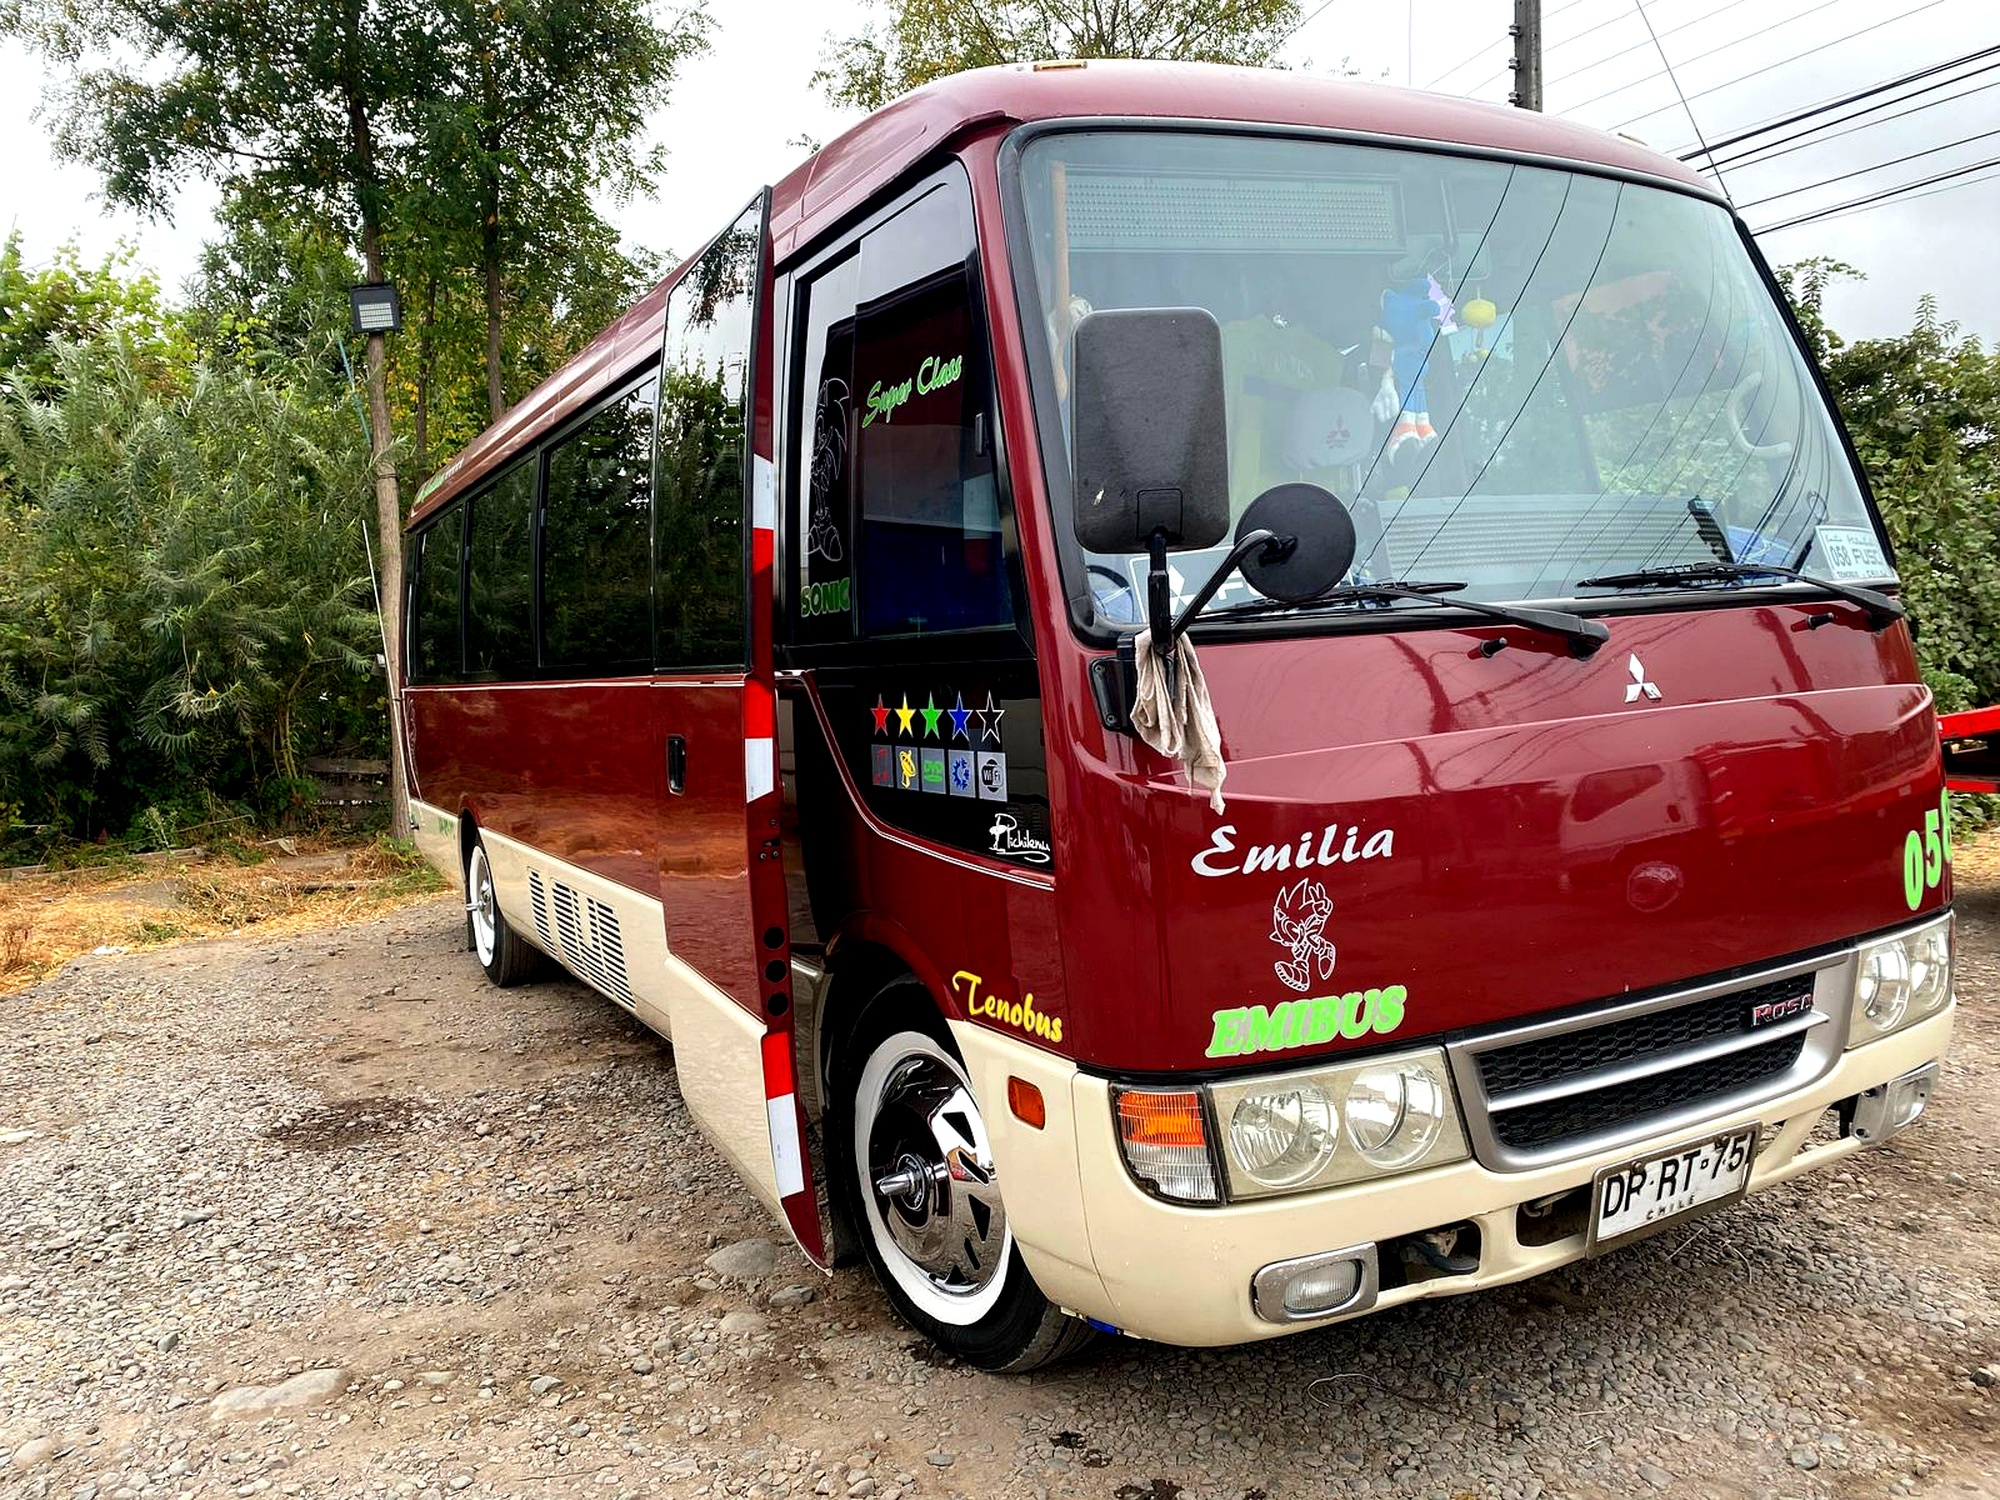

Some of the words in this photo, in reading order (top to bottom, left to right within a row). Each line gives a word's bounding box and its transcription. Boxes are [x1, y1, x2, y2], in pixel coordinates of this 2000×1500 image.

[861, 381, 911, 428] Super
[917, 355, 963, 395] Class
[801, 577, 850, 618] SONIC
[1191, 824, 1395, 876] Emilia
[952, 970, 1063, 1042] Tenobus
[1205, 985, 1408, 1058] EMIBUS
[1646, 1194, 1695, 1220] CHILE
